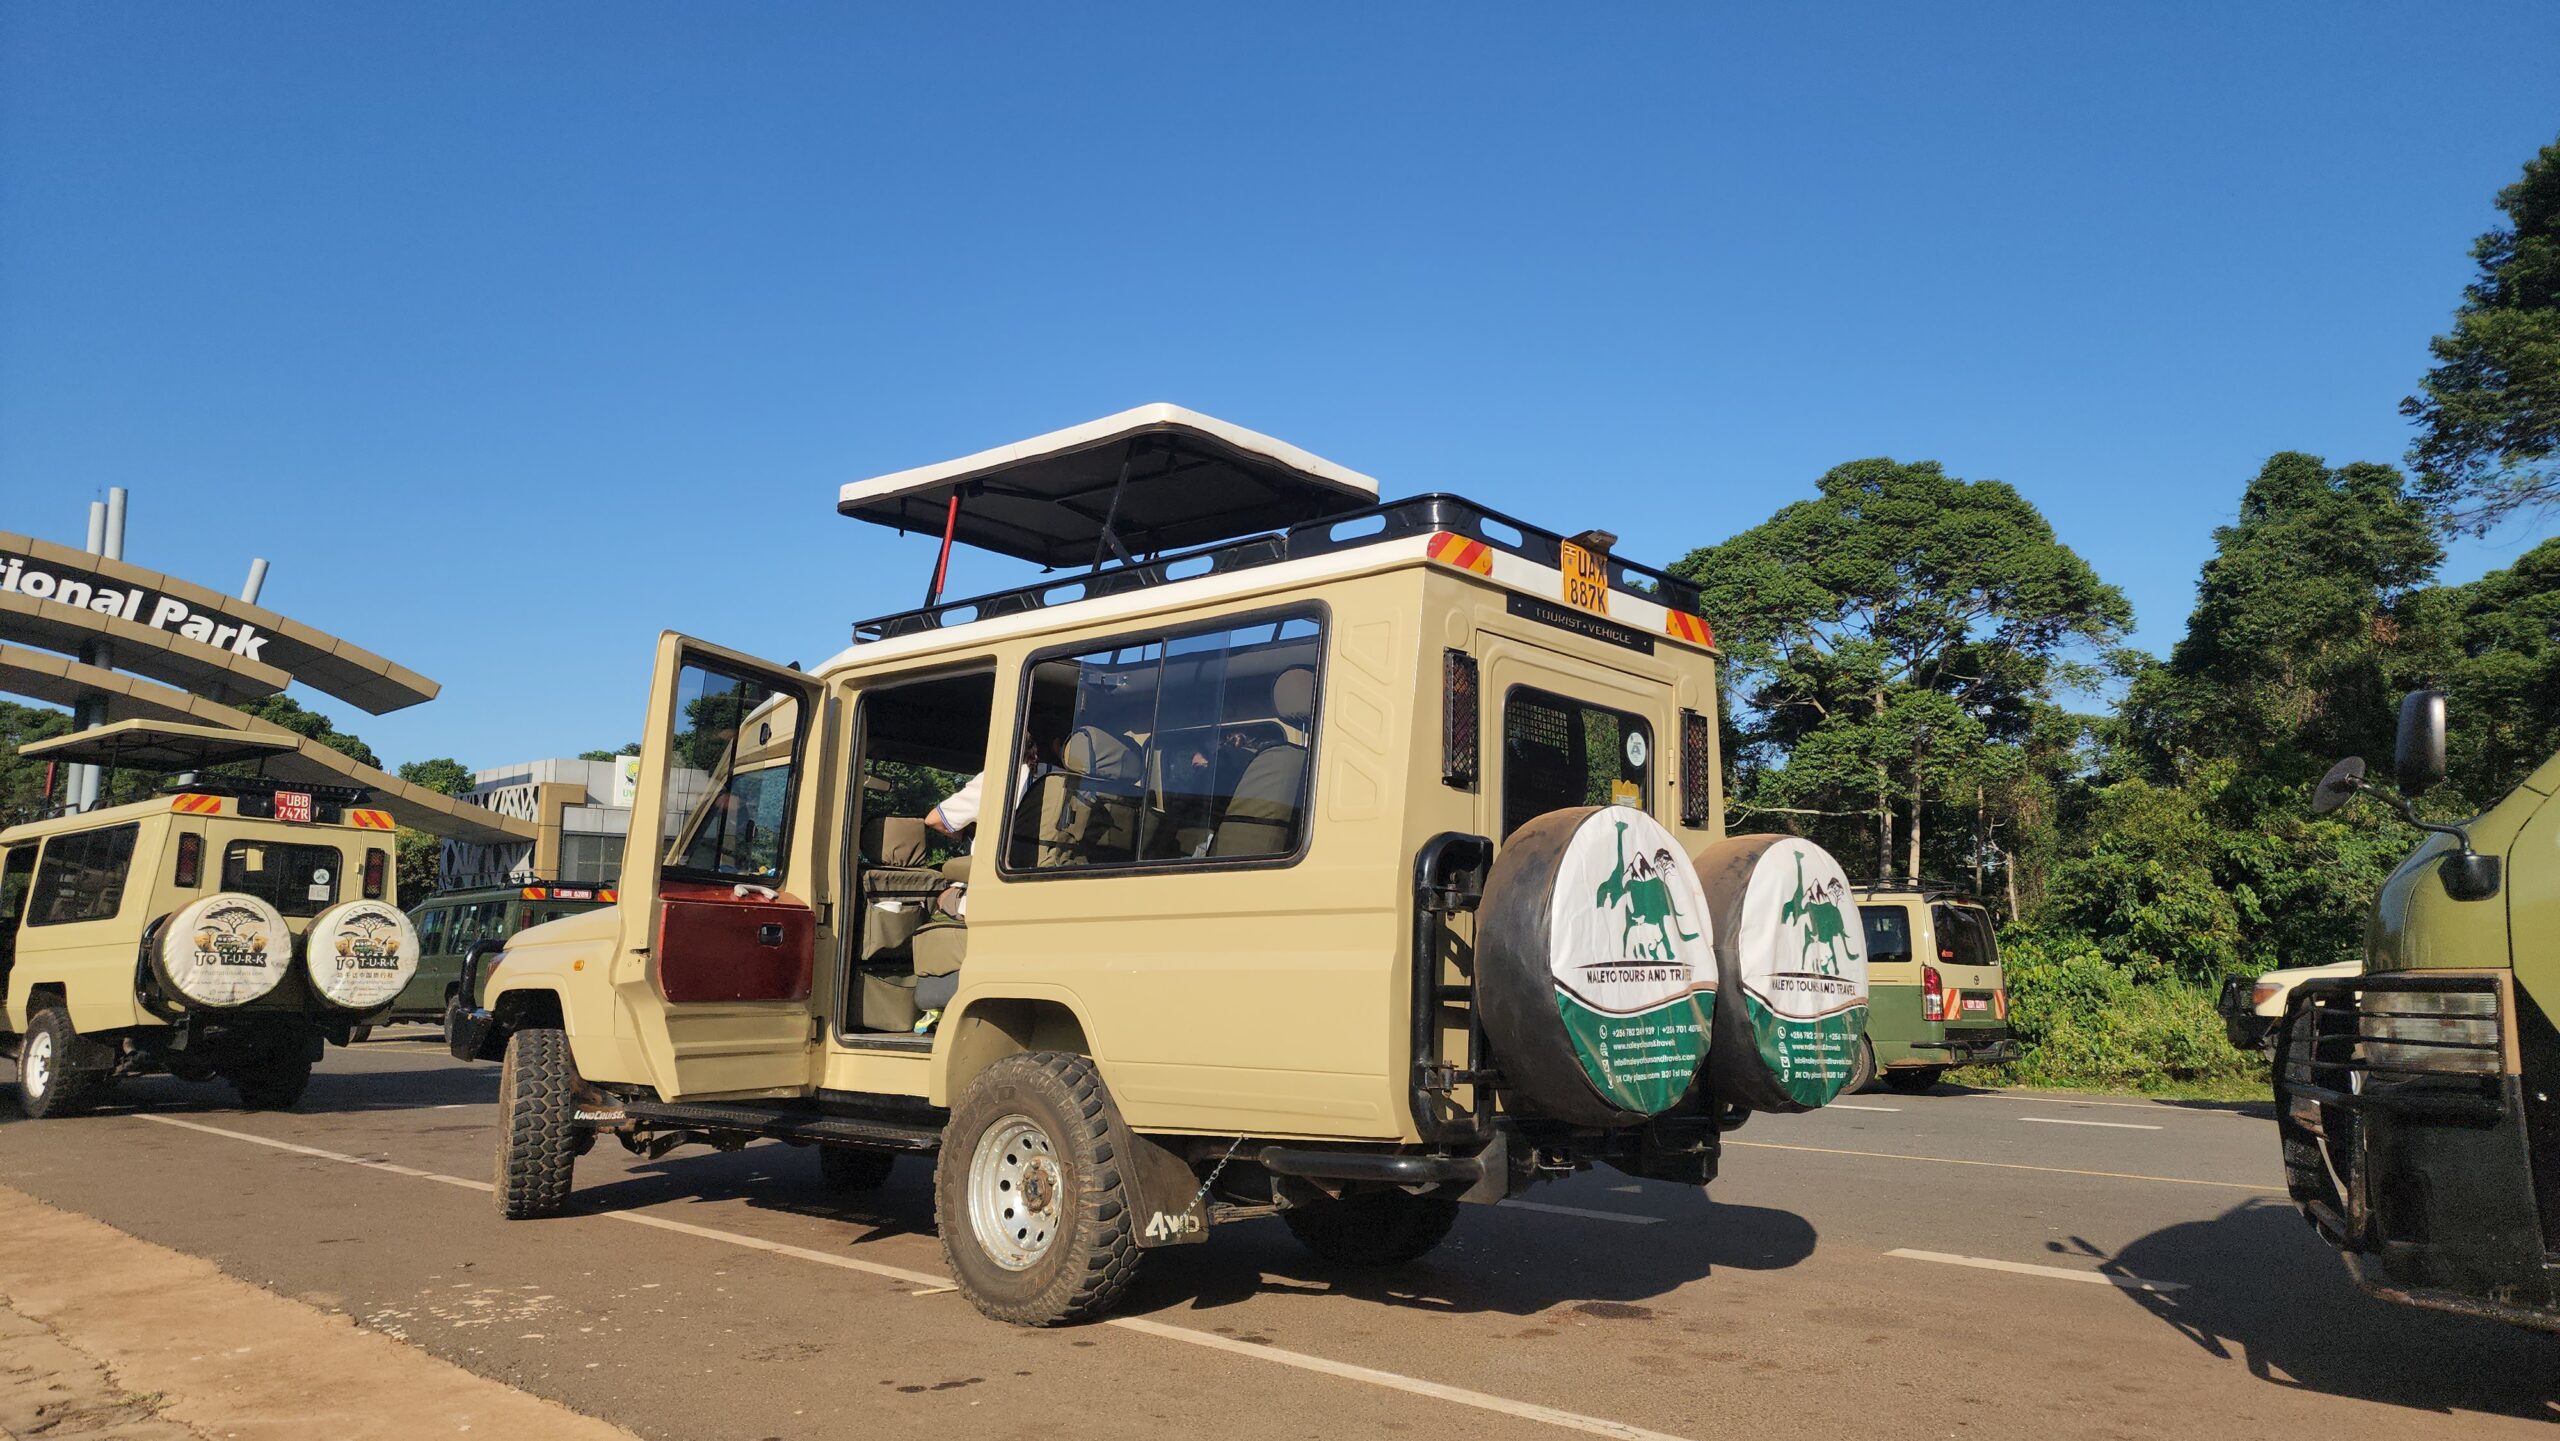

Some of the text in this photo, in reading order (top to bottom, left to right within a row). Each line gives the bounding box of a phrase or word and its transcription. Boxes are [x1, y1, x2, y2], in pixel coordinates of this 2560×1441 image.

[1578, 549, 1607, 586] UAX
[1570, 578, 1607, 615] 887K
[149, 596, 268, 662] Park
[279, 806, 309, 819] 747R
[287, 794, 309, 807] UBB
[1586, 970, 1617, 984] NALEYO
[1618, 970, 1646, 983] TOURS
[1648, 969, 1667, 982] AND
[1145, 1211, 1200, 1241] 4WD
